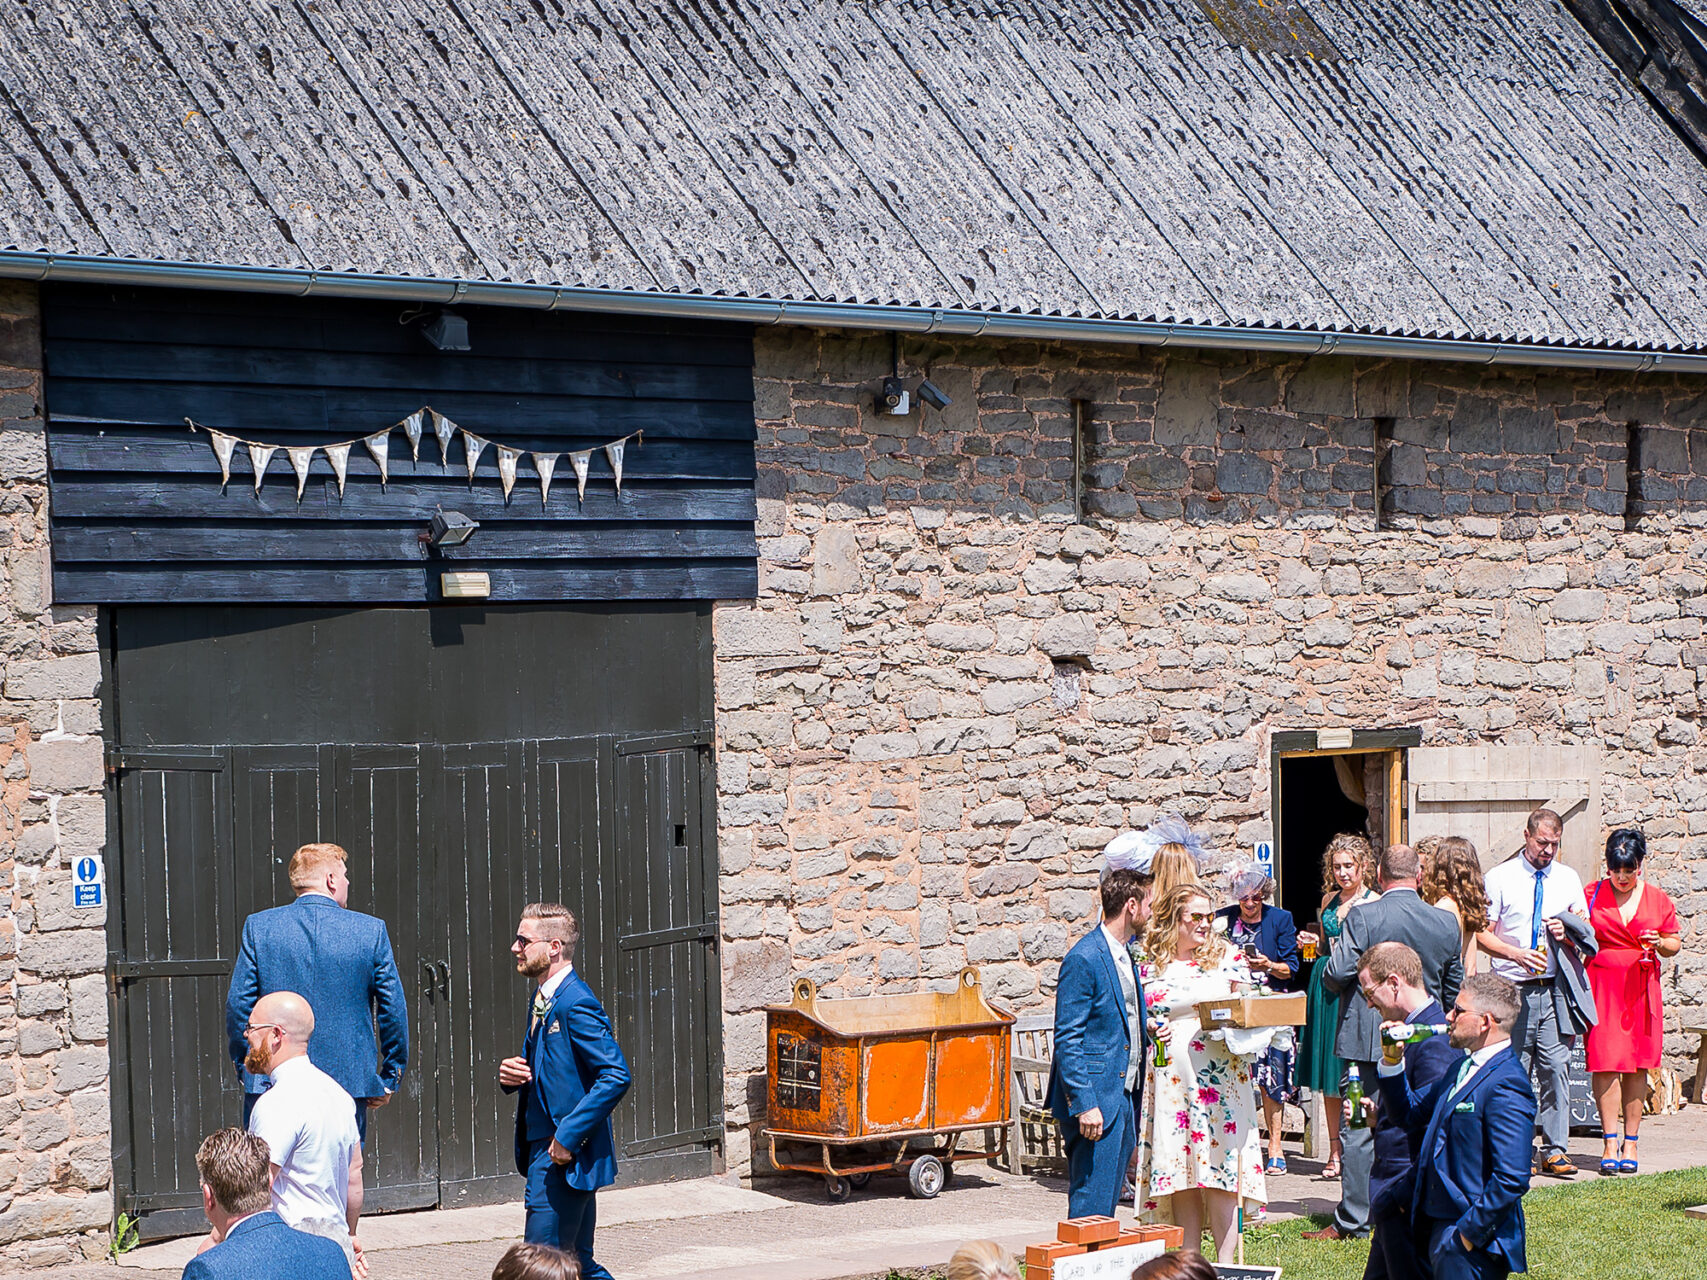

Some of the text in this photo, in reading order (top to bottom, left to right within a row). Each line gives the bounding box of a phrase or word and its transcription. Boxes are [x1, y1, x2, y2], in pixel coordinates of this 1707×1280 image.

[219, 413, 625, 479] JUST MARRIED
[80, 885, 97, 893] Keep
[81, 893, 96, 901] clear
[1061, 1262, 1086, 1280] CARD
[1092, 1262, 1103, 1275] UP
[1109, 1255, 1125, 1272] THE
